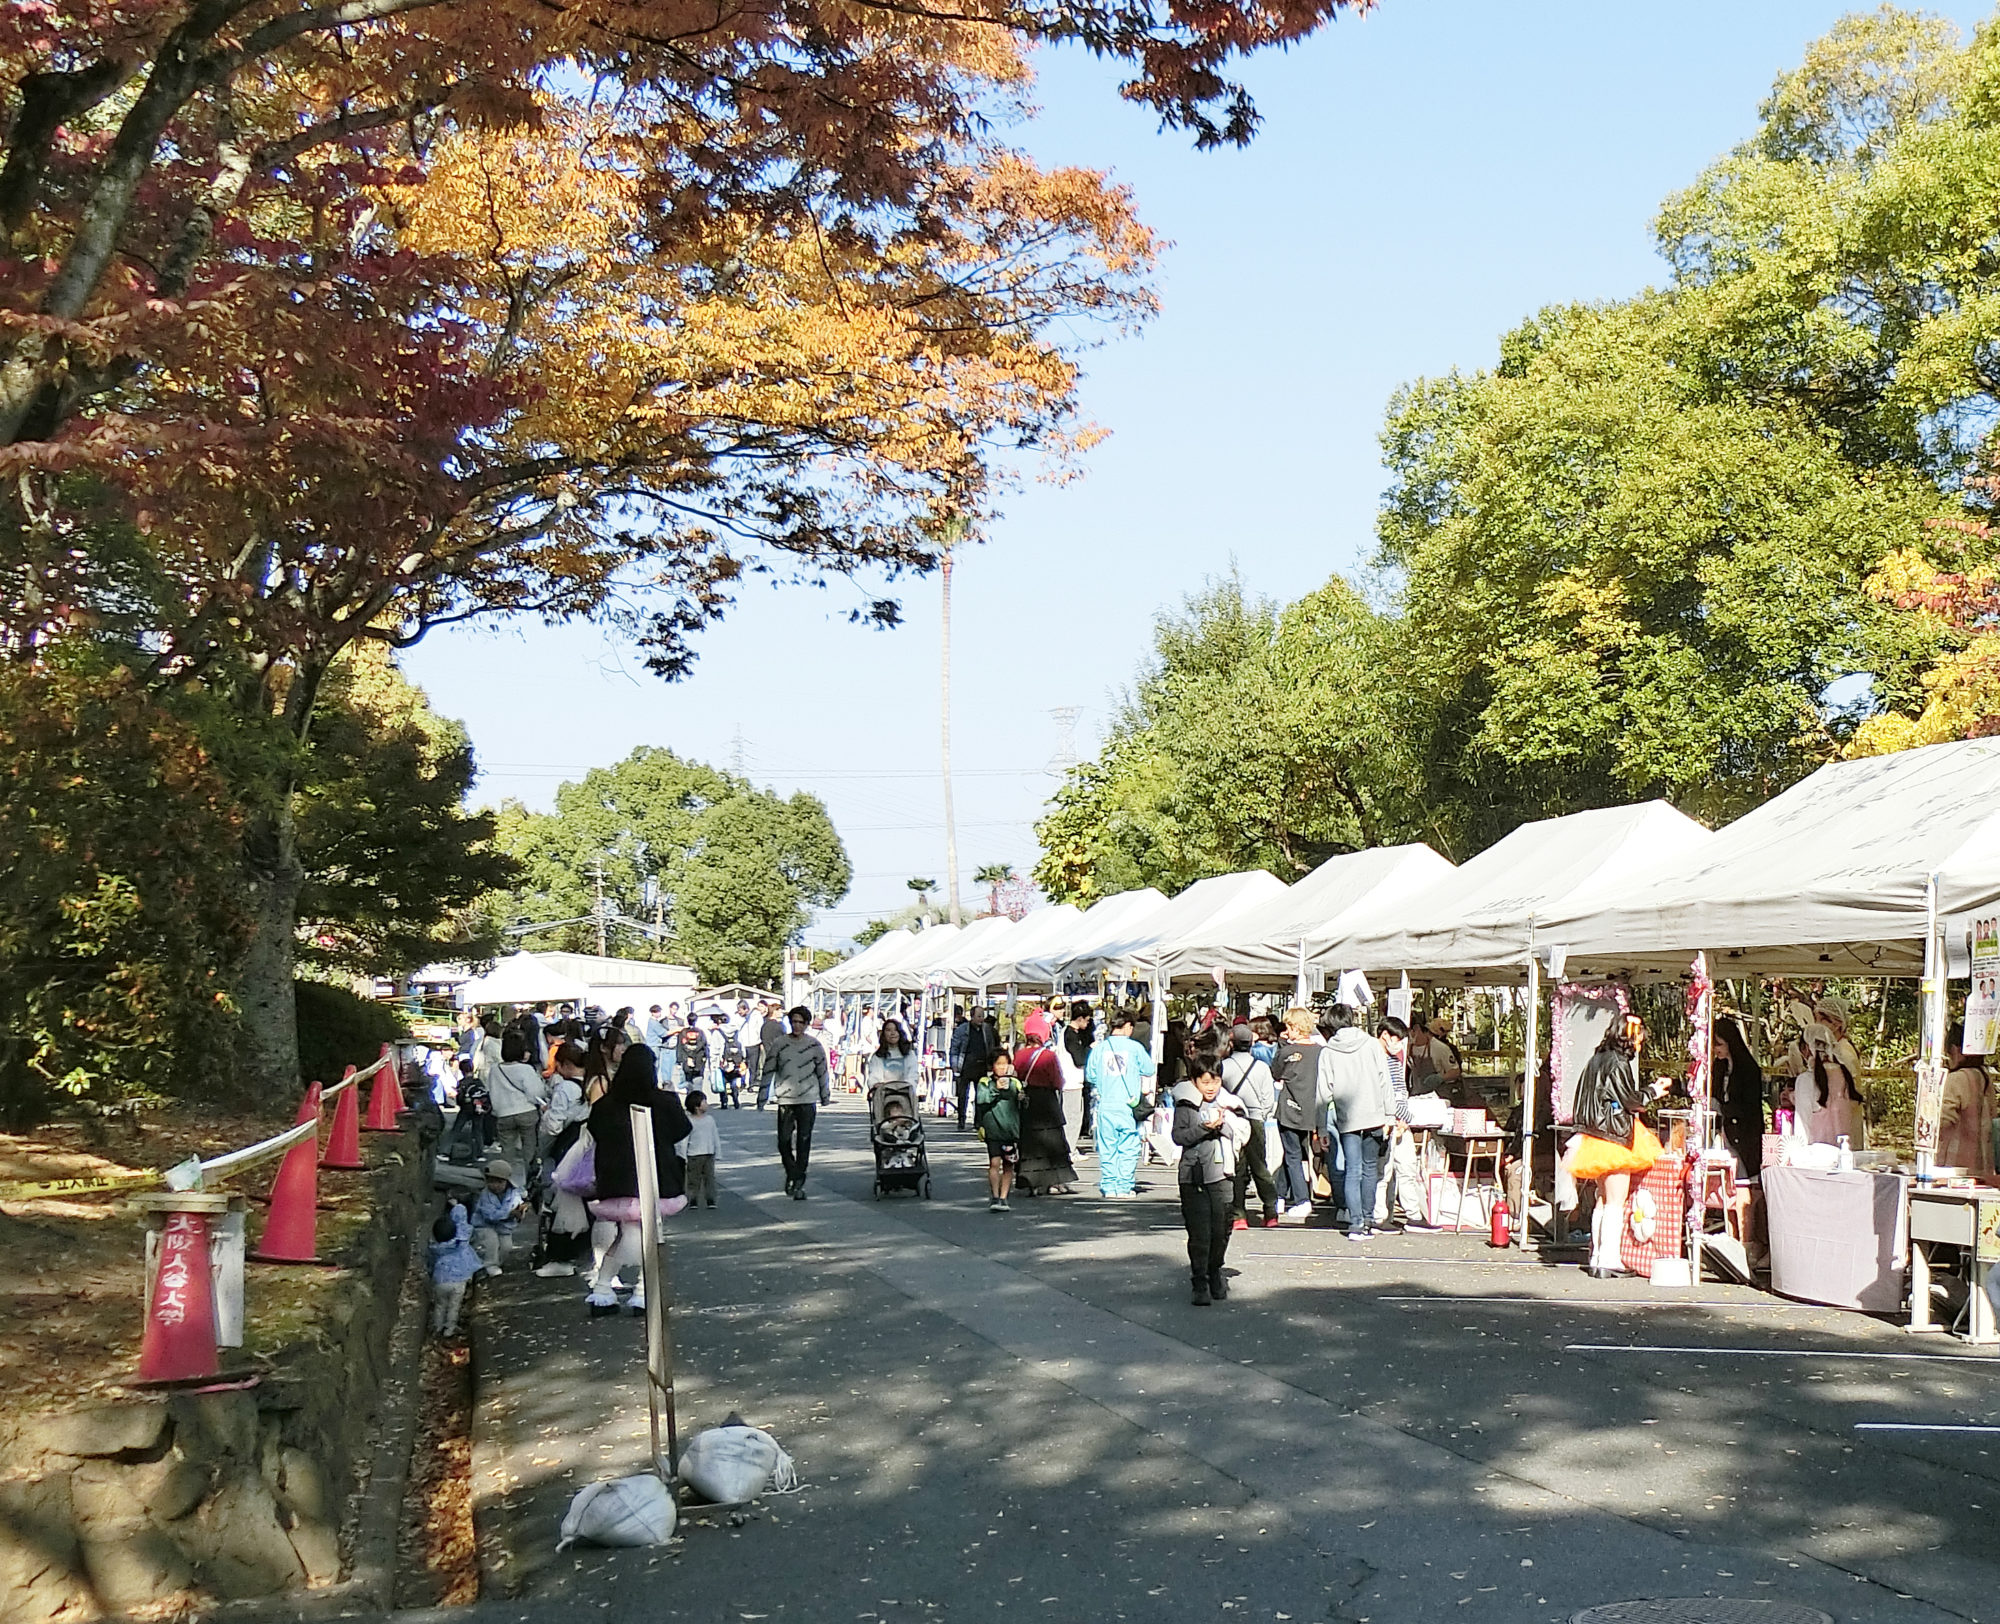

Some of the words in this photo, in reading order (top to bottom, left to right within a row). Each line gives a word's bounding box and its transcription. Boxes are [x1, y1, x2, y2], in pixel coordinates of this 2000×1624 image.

[155, 1215, 202, 1326] 大阪大谷大学
